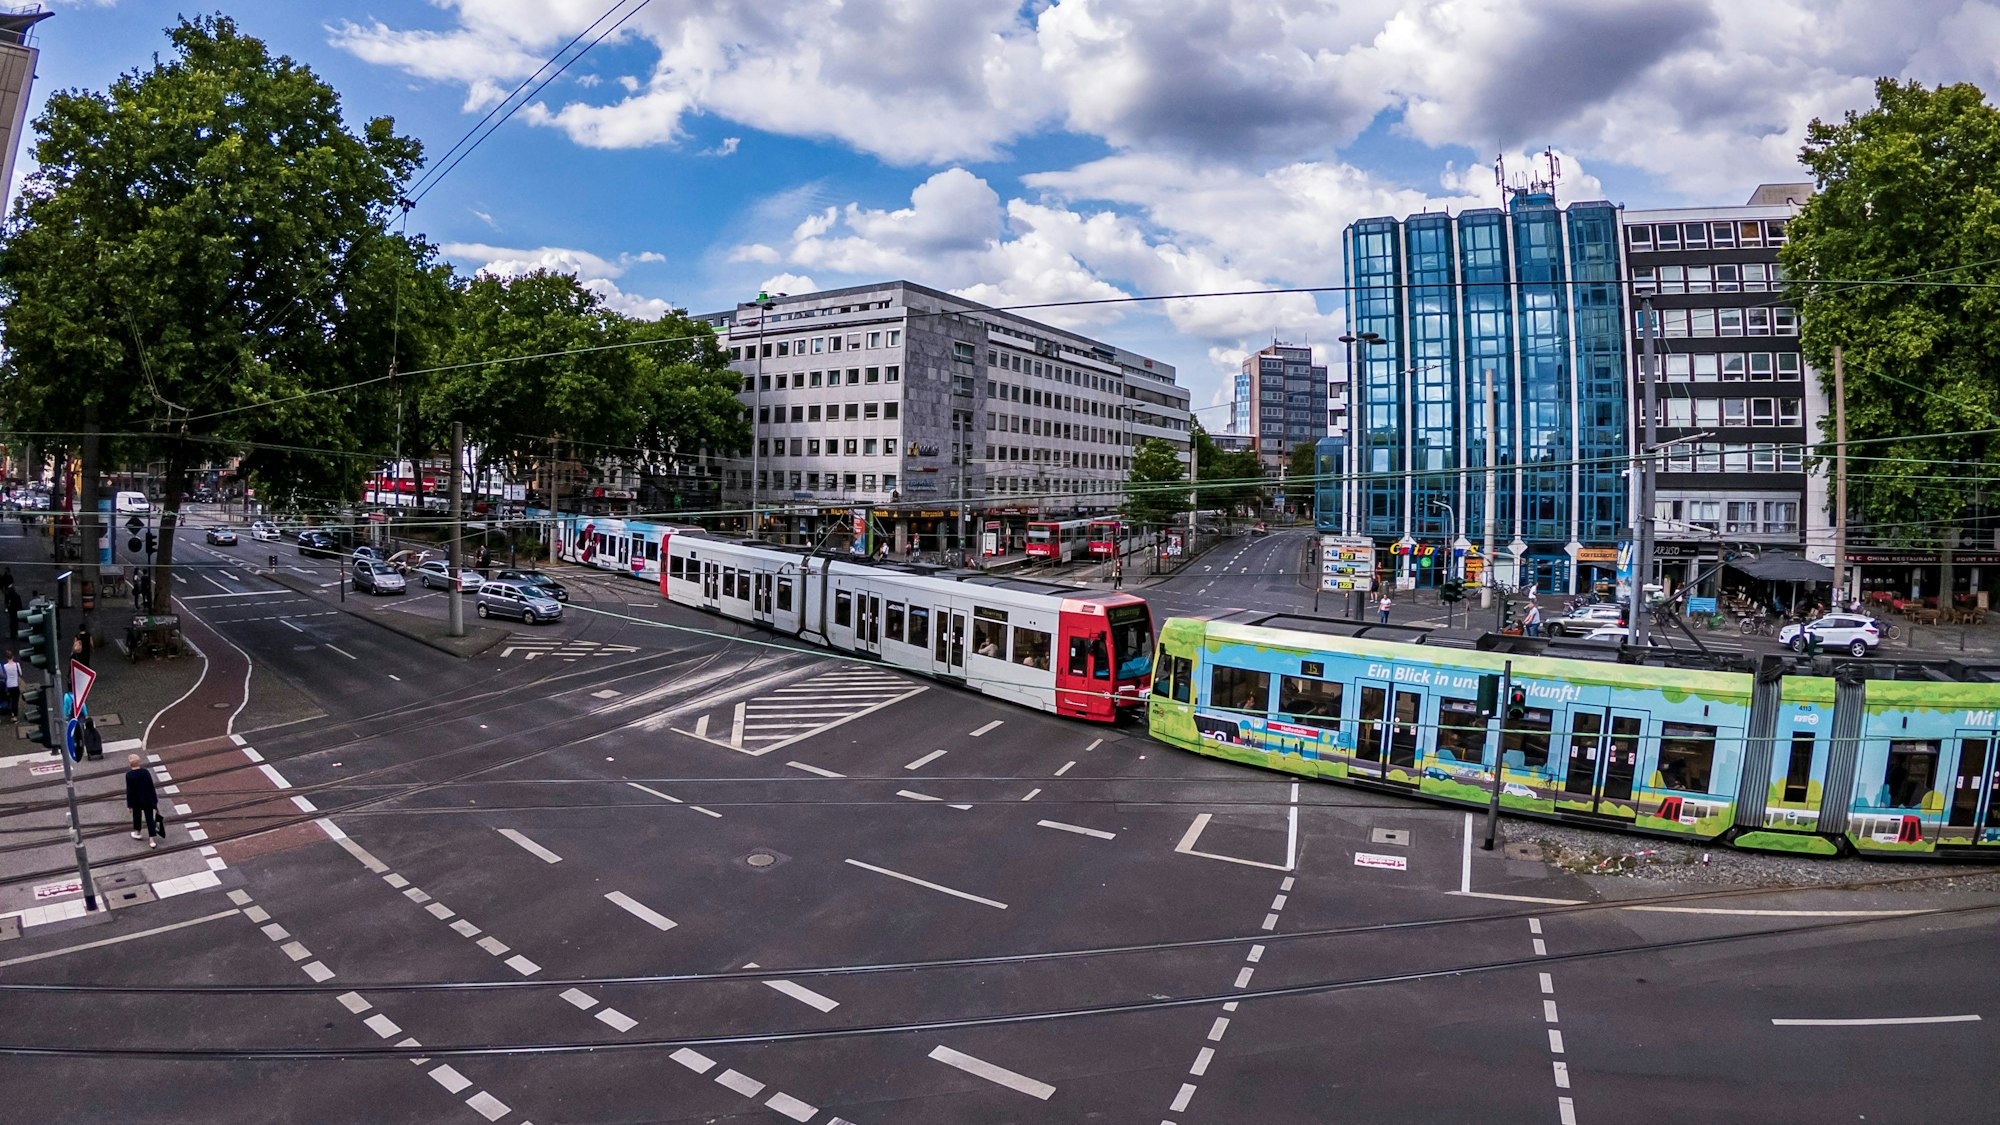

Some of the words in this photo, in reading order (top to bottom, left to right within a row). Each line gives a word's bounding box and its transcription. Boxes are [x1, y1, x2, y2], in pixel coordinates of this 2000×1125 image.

[1653, 546, 1680, 555] ARUSO
[1309, 663, 1318, 673] 15
[1367, 663, 1390, 679] Ein
[1394, 666, 1430, 684] Blick
[1434, 674, 1449, 686] in
[1964, 710, 1995, 726] Mit
